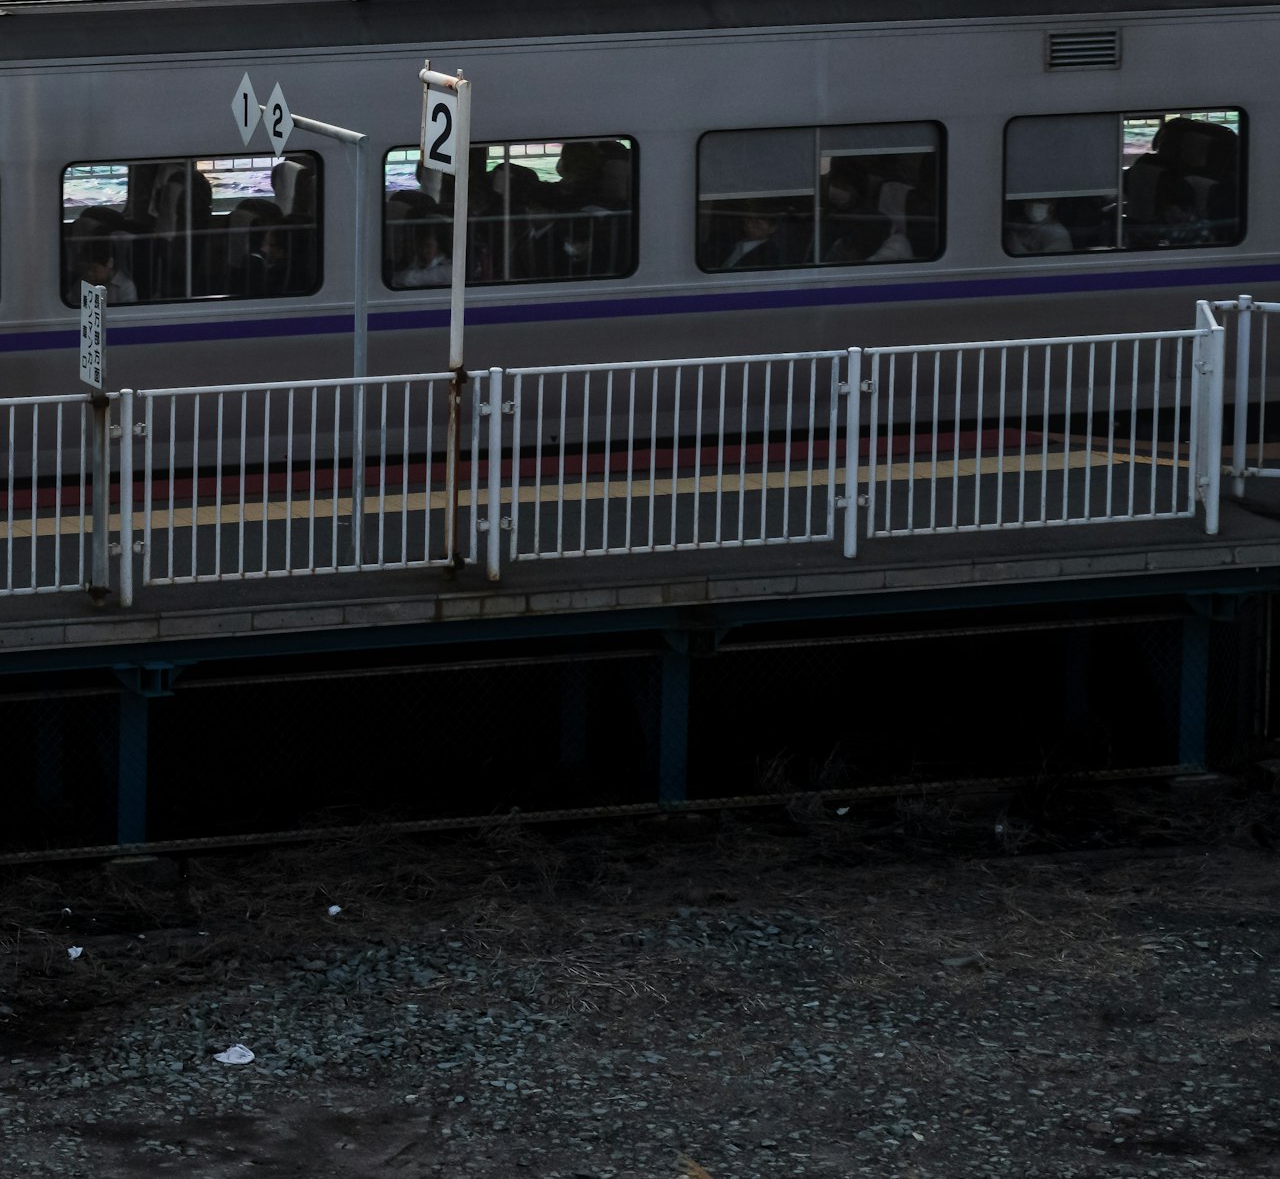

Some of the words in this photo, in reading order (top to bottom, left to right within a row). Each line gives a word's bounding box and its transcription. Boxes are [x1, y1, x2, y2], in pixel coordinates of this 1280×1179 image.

[242, 92, 249, 128] 1
[272, 103, 284, 139] 2
[430, 102, 452, 165] 2
